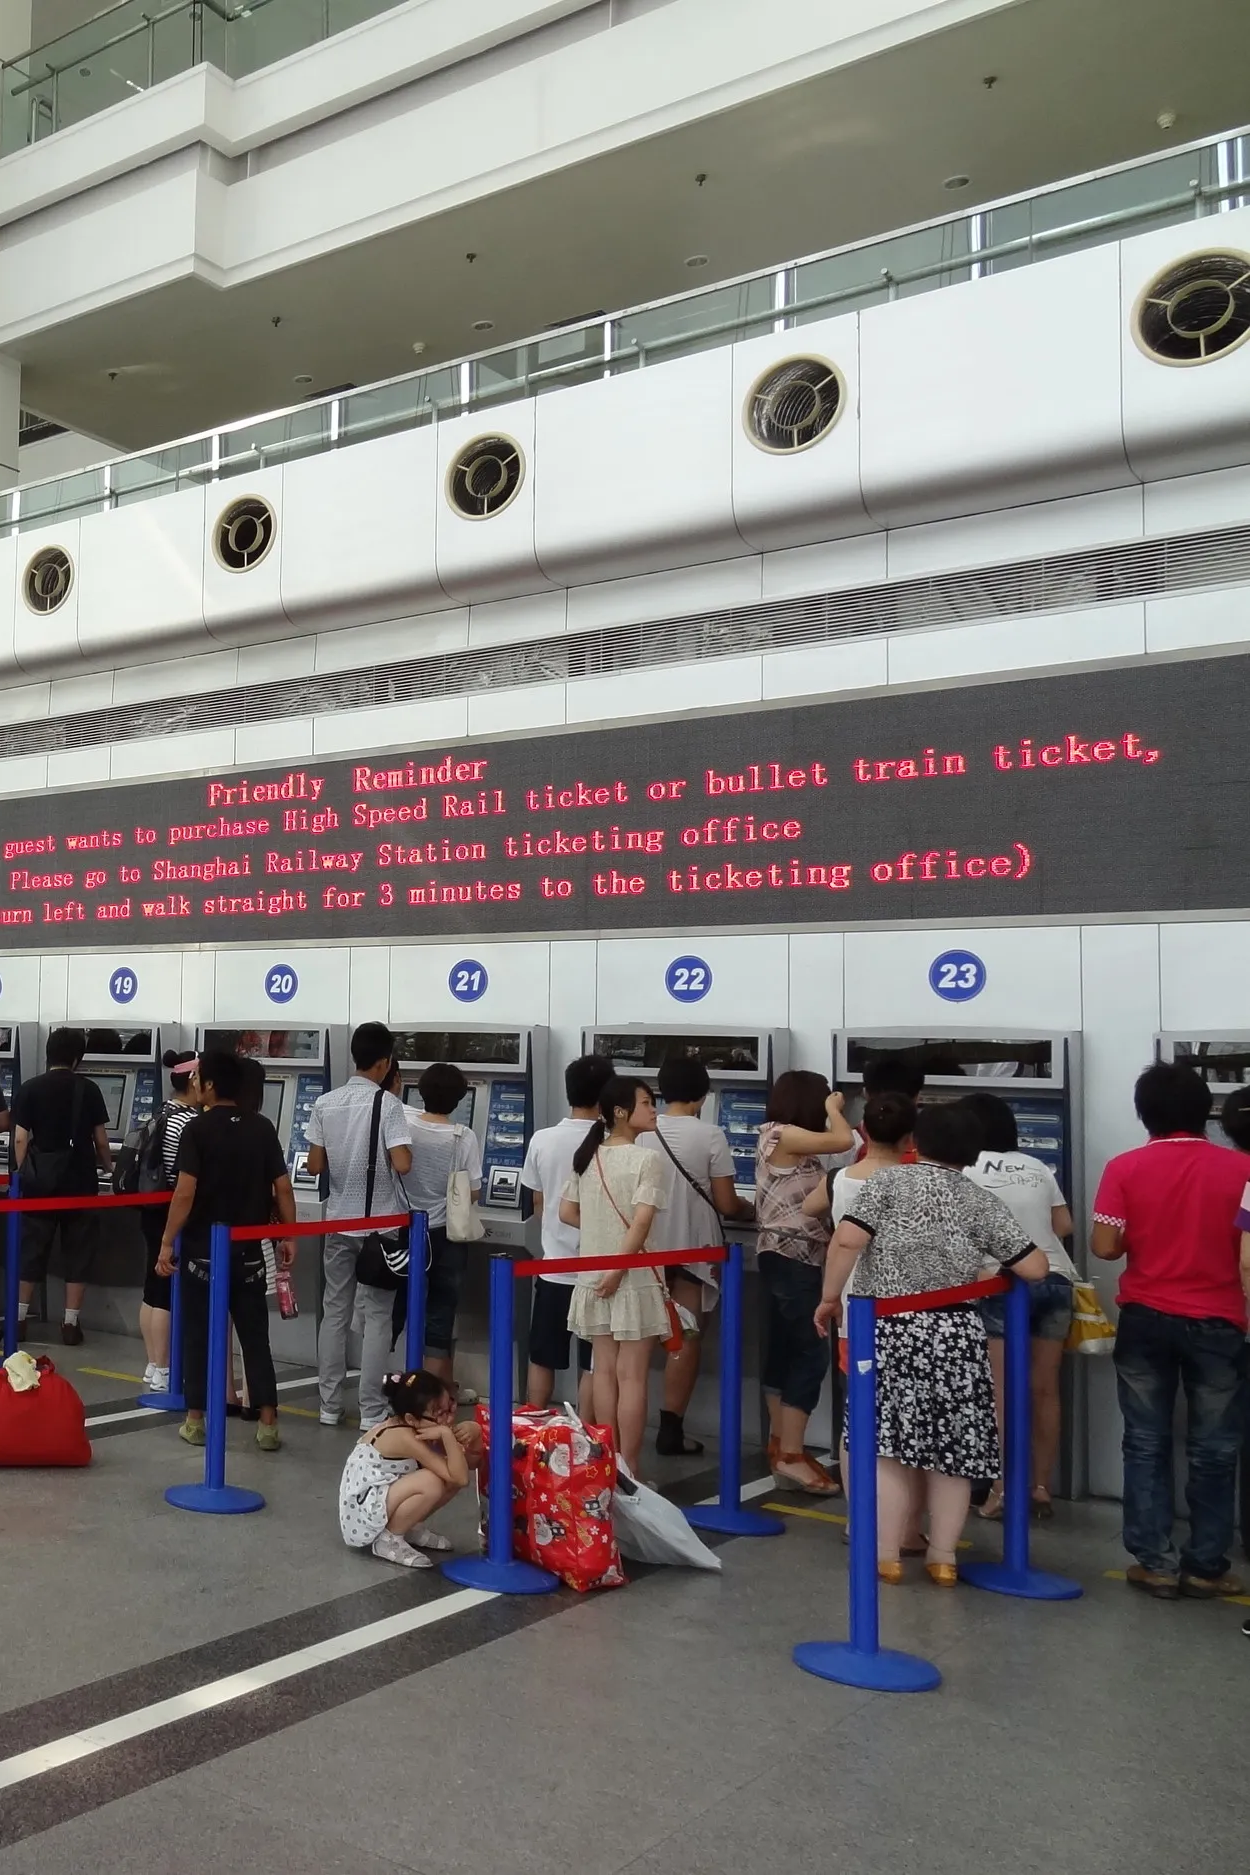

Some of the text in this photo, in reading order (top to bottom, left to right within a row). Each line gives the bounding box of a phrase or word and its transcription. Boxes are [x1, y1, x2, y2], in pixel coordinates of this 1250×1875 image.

[207, 756, 487, 808] Friendly Reminder
[5, 836, 55, 859] guest
[65, 830, 123, 851] wants
[134, 828, 157, 845] to
[167, 816, 270, 846] purchase
[283, 807, 339, 835] High
[352, 798, 427, 830] Speed
[442, 790, 505, 819] Rail
[526, 781, 628, 811] ticket
[646, 780, 686, 801] or
[705, 763, 828, 796] bullet
[852, 748, 966, 783] train
[992, 733, 1160, 770] ticket,
[9, 816, 801, 890] Please go to Shanghai Railway Station ticketing office
[43, 901, 86, 923] left
[95, 900, 132, 920] and
[141, 894, 190, 918] walk
[202, 889, 307, 916] straight
[322, 886, 365, 909] for
[378, 882, 395, 906] 3
[407, 880, 521, 905] minutes
[539, 876, 573, 899] to
[592, 869, 645, 896] the
[667, 860, 852, 893] ticketing
[870, 842, 1031, 883] office)
[114, 977, 133, 995] 19
[269, 975, 293, 994] 20
[455, 971, 481, 991] 21
[673, 968, 705, 991] 22
[938, 964, 977, 989] 23
